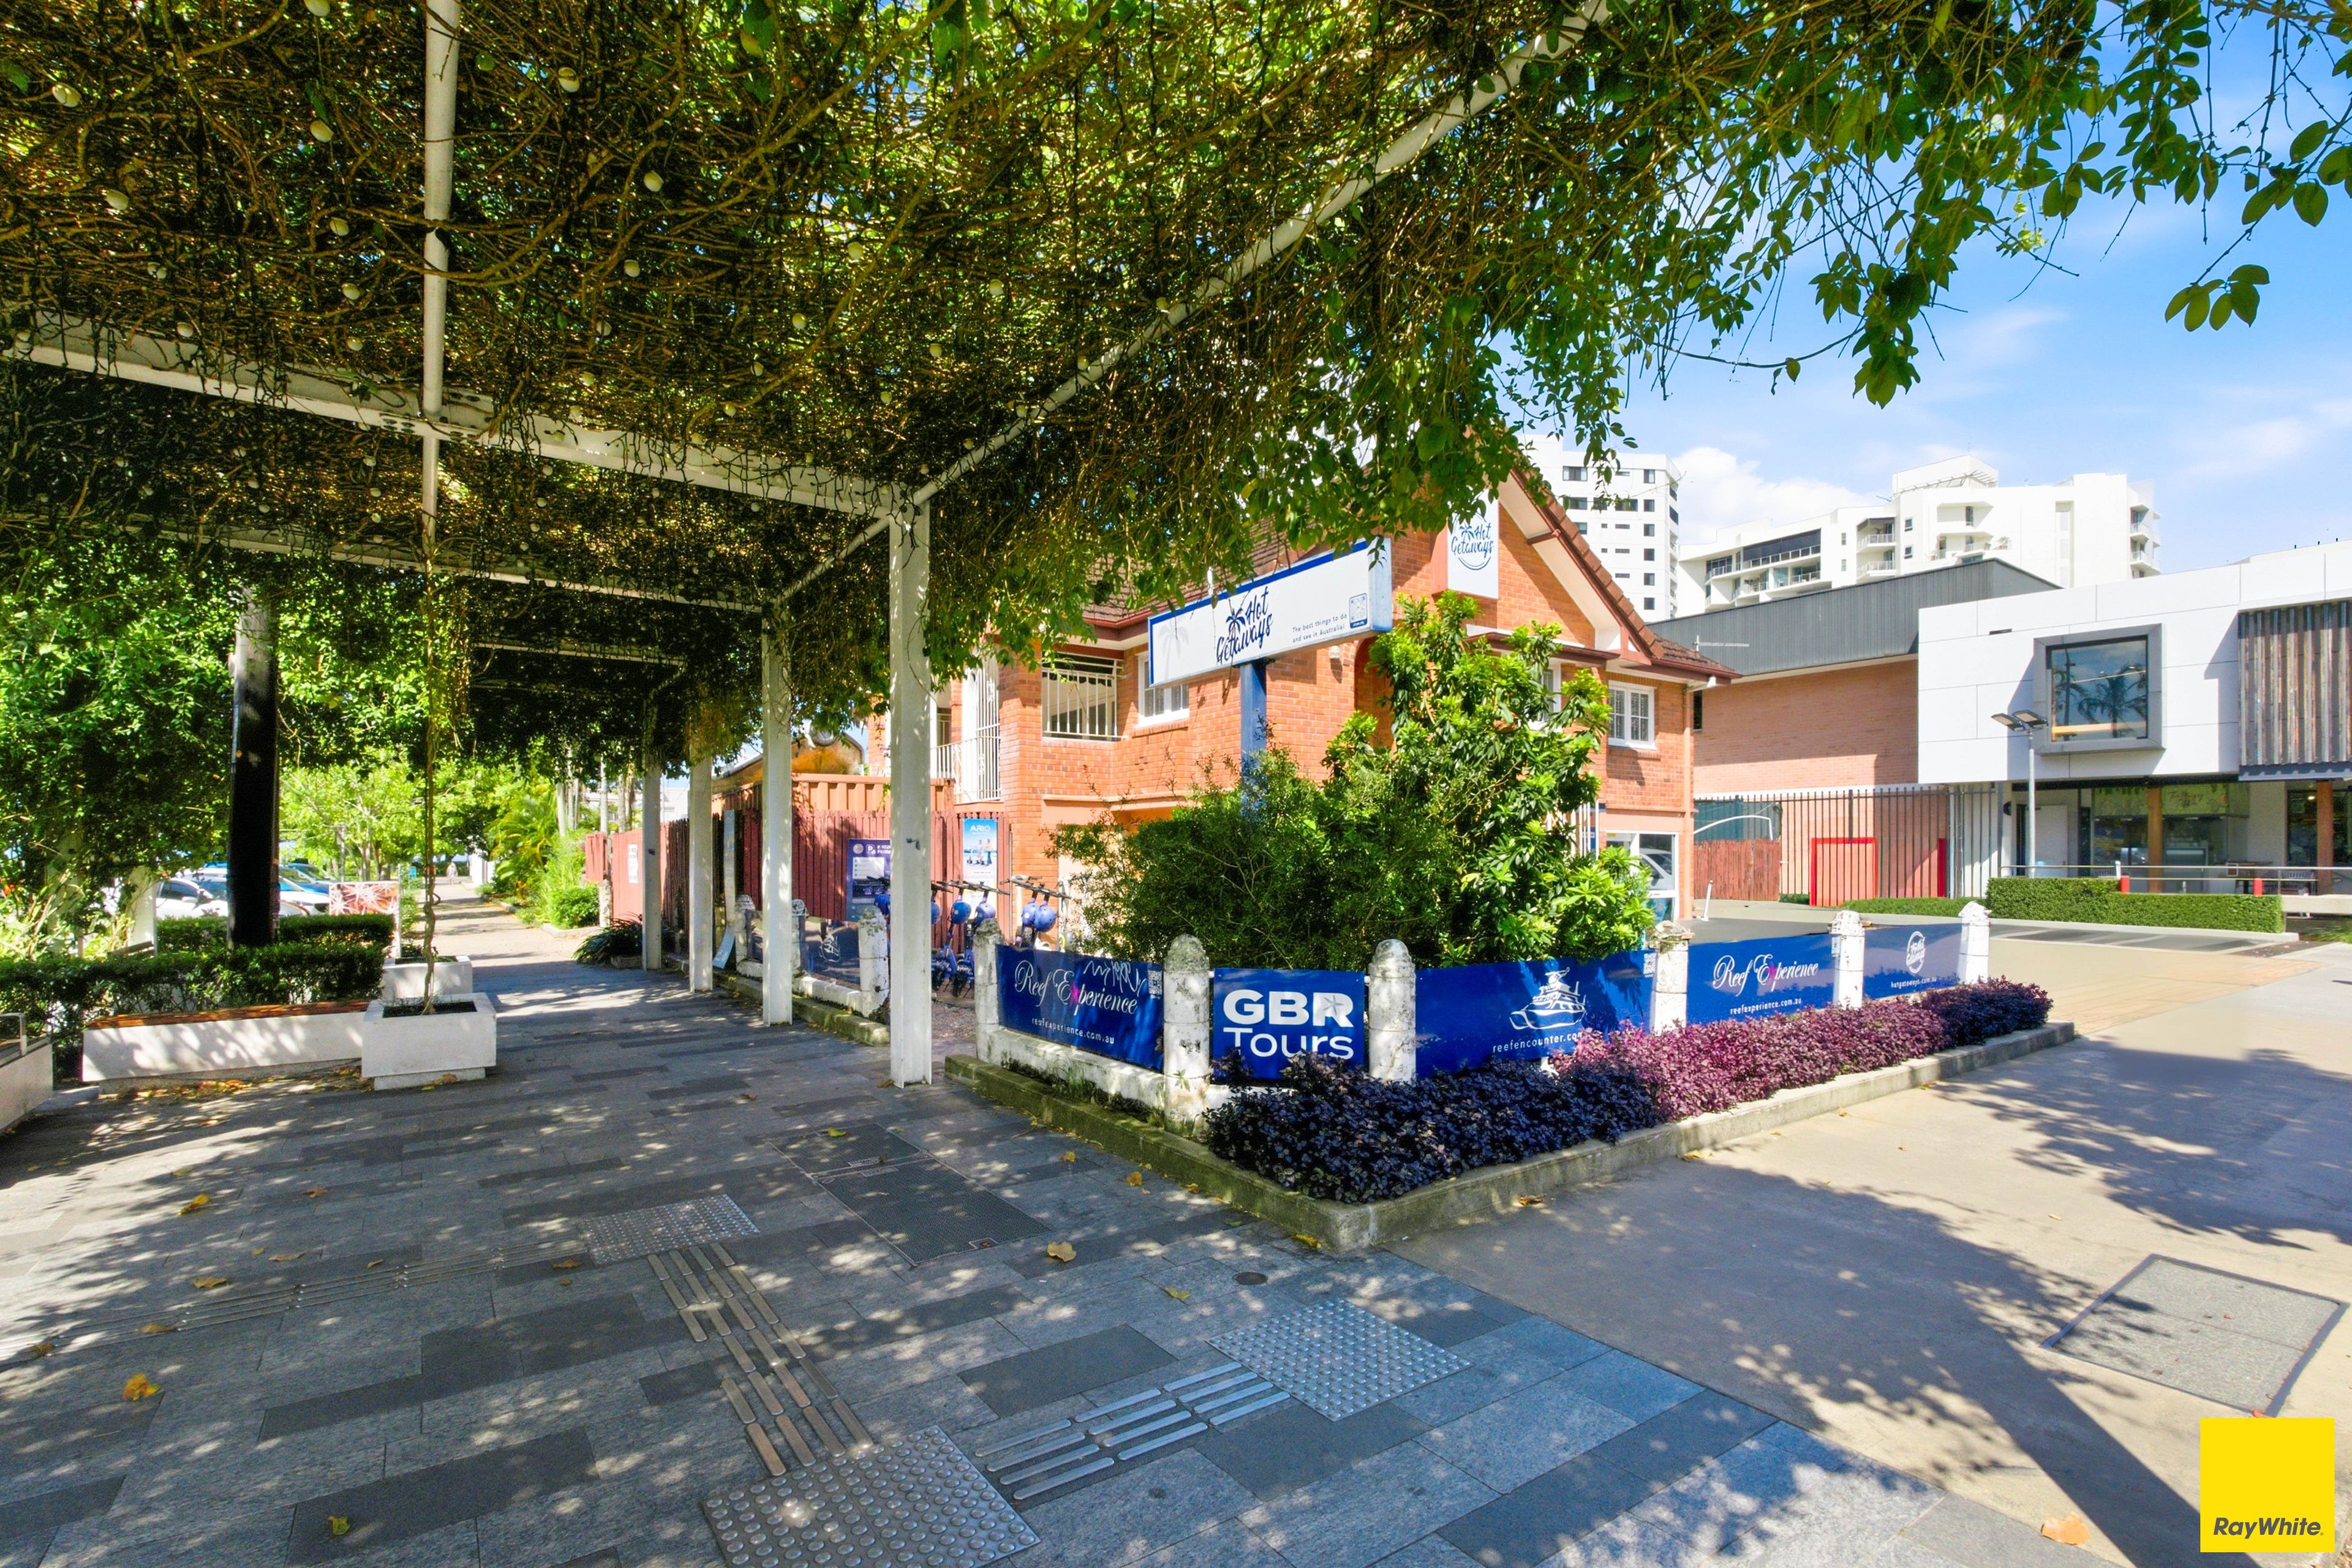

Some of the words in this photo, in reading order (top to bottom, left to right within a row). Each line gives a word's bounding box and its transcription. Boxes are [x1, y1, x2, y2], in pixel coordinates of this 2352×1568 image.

[1451, 536, 1493, 559] Getaways
[1474, 522, 1491, 540] Hot
[1245, 586, 1269, 625] Hot
[1216, 614, 1273, 665] Getaways
[1014, 960, 1052, 1007] Reef
[1713, 955, 1753, 997] Reef
[1223, 989, 1354, 1027] GBR
[1031, 1017, 1115, 1044] reefexperience.com.au
[1223, 1027, 1354, 1060] Tours
